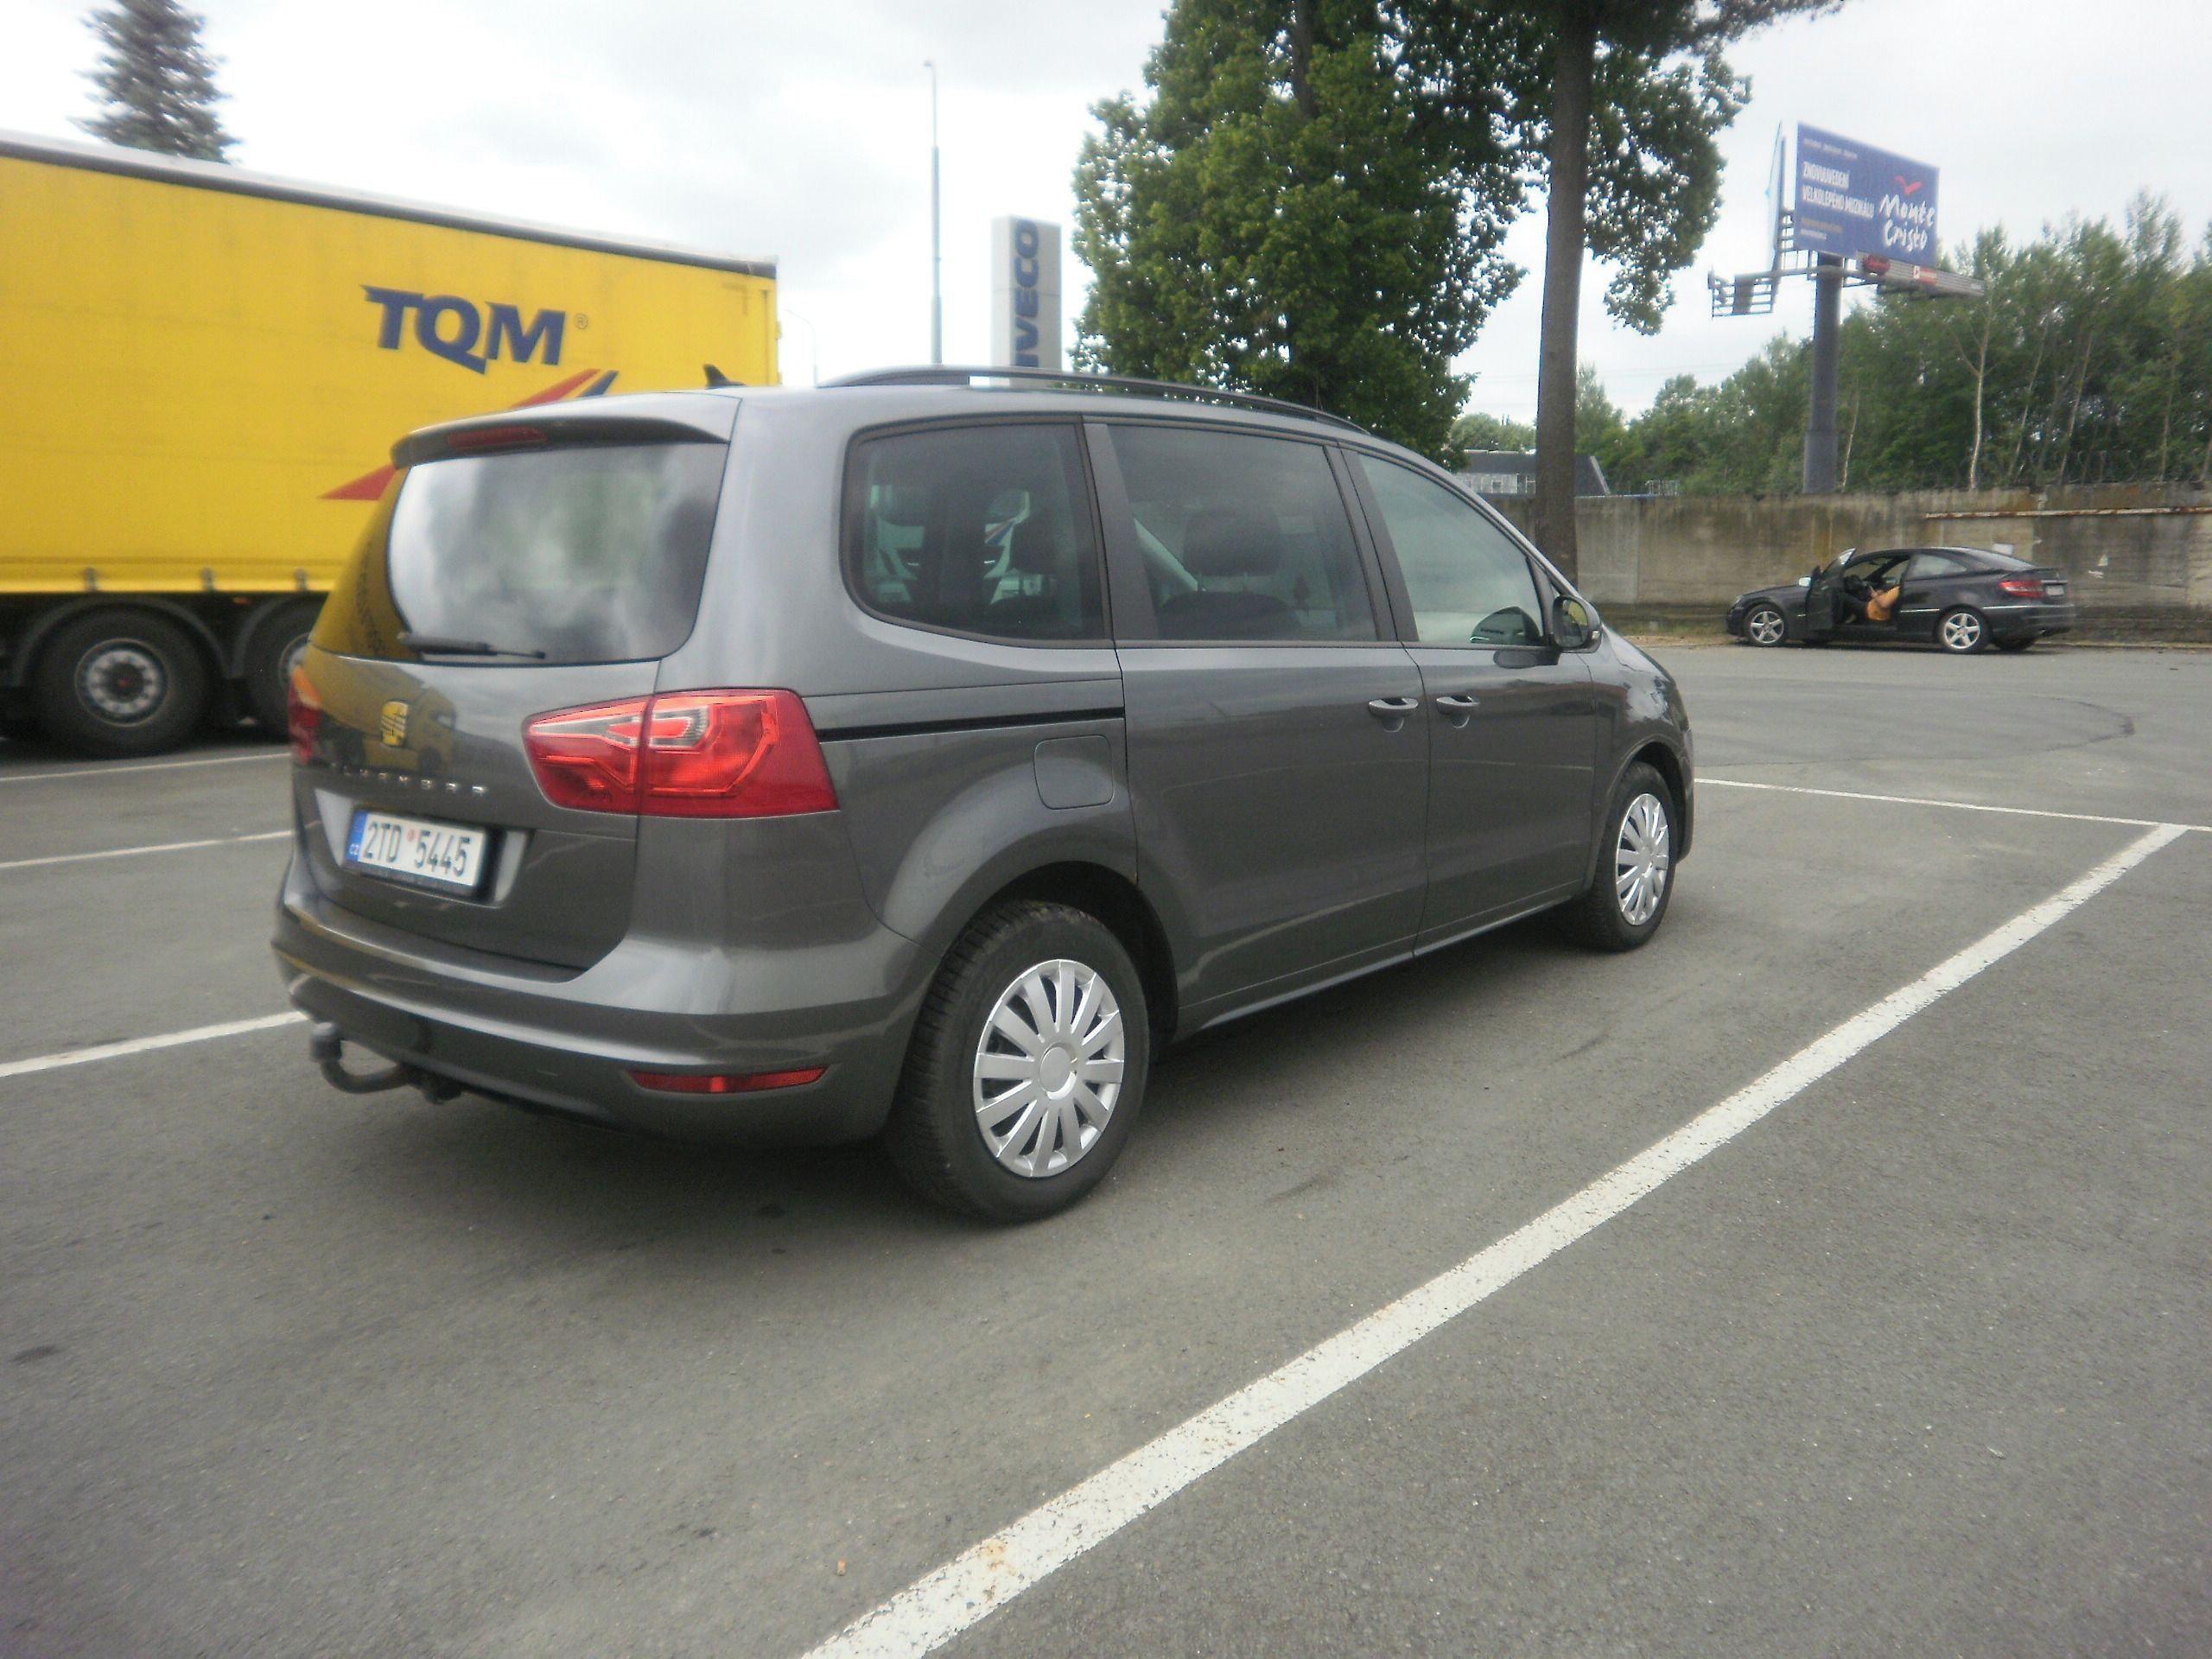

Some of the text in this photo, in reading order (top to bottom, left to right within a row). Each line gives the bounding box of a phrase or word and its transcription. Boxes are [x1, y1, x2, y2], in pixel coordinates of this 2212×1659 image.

[1879, 193, 1936, 227] Monte
[1884, 219, 1928, 251] Cristo
[1014, 219, 1039, 367] IVECO
[359, 284, 566, 375] TQM
[415, 829, 471, 877] 5445
